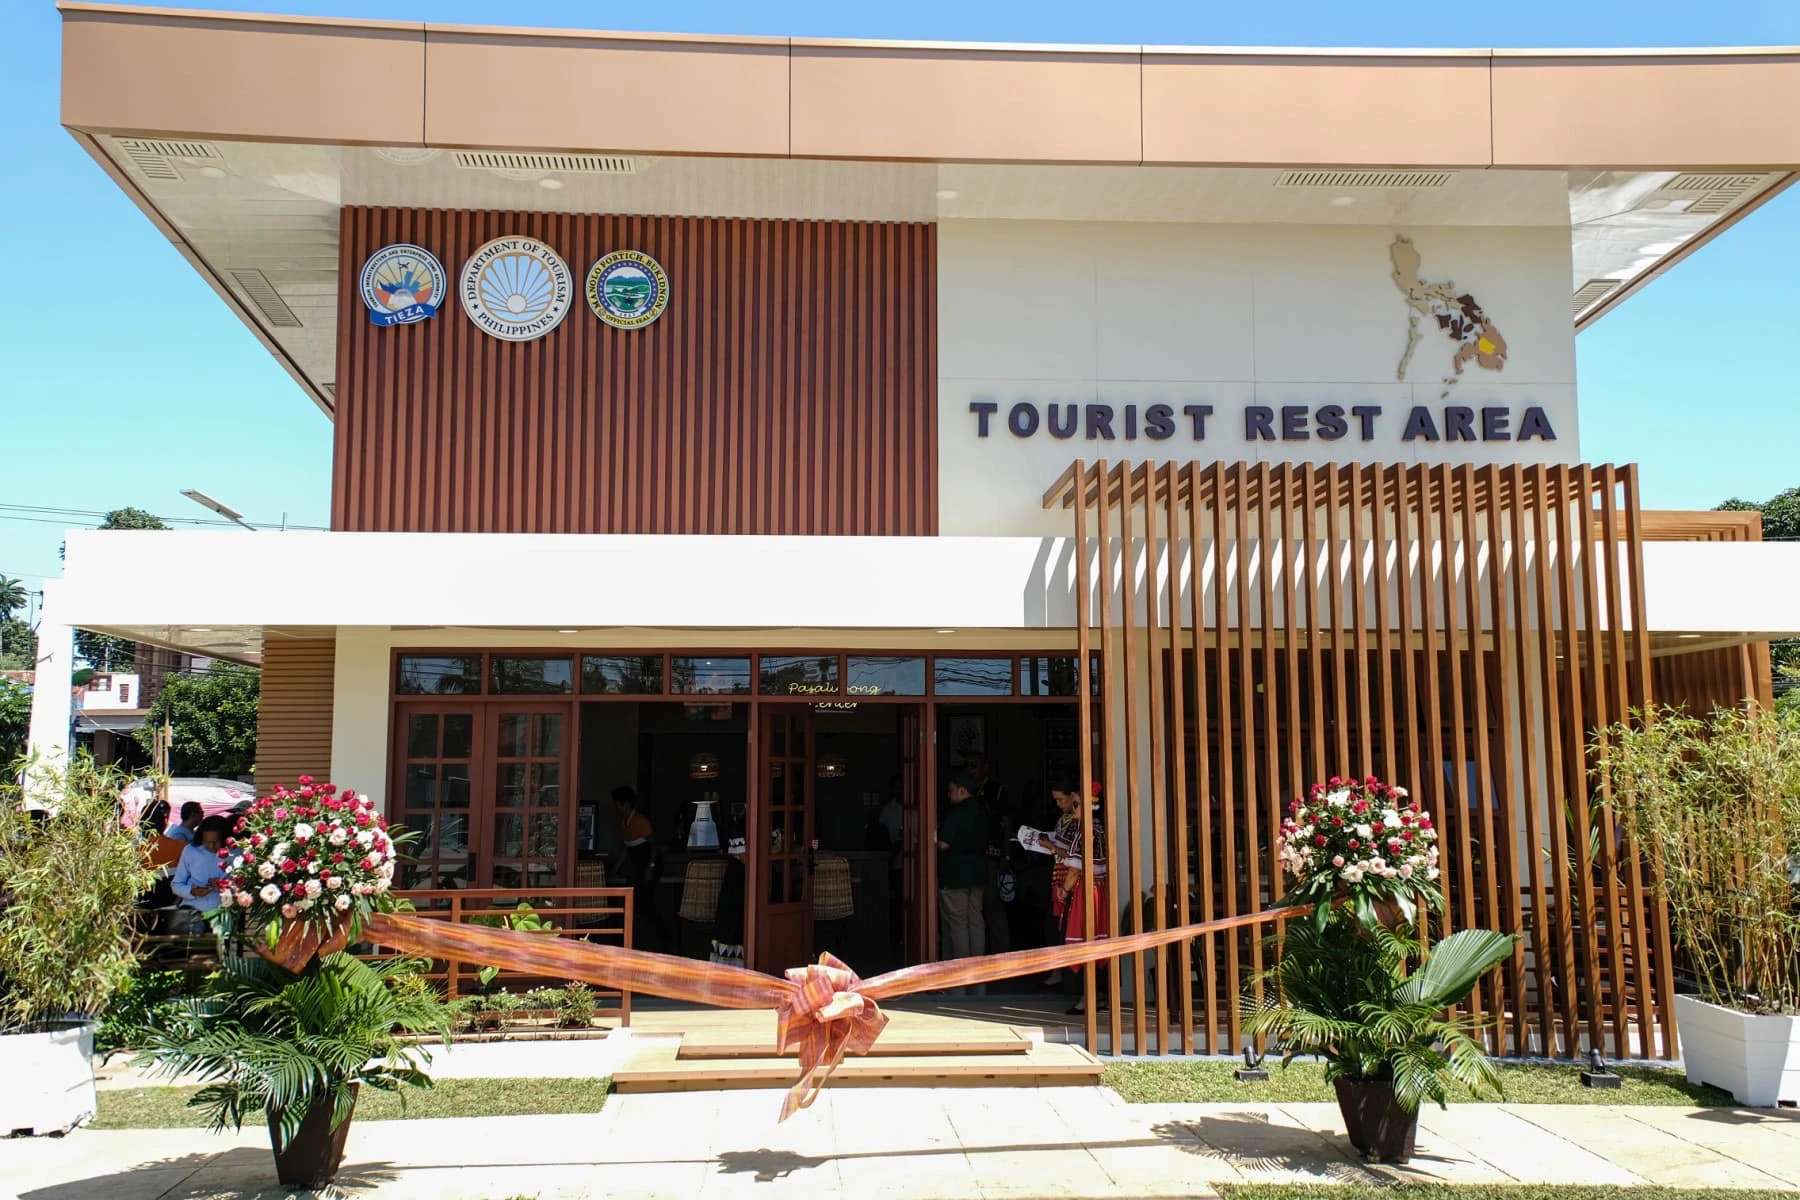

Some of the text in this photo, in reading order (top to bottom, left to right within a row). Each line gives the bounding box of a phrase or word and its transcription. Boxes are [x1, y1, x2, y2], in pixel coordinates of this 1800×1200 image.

[467, 241, 566, 303] DEPARTMENT OF TOURISM
[589, 267, 602, 308] MANOLO
[645, 260, 666, 308] BUKIDNON
[384, 305, 425, 325] TIEZA
[478, 312, 554, 335] PHILIPPINES
[605, 315, 635, 325] OFFICIAL
[969, 402, 1557, 441] TOURIST REST AREA
[788, 682, 881, 695] Pasaluong
